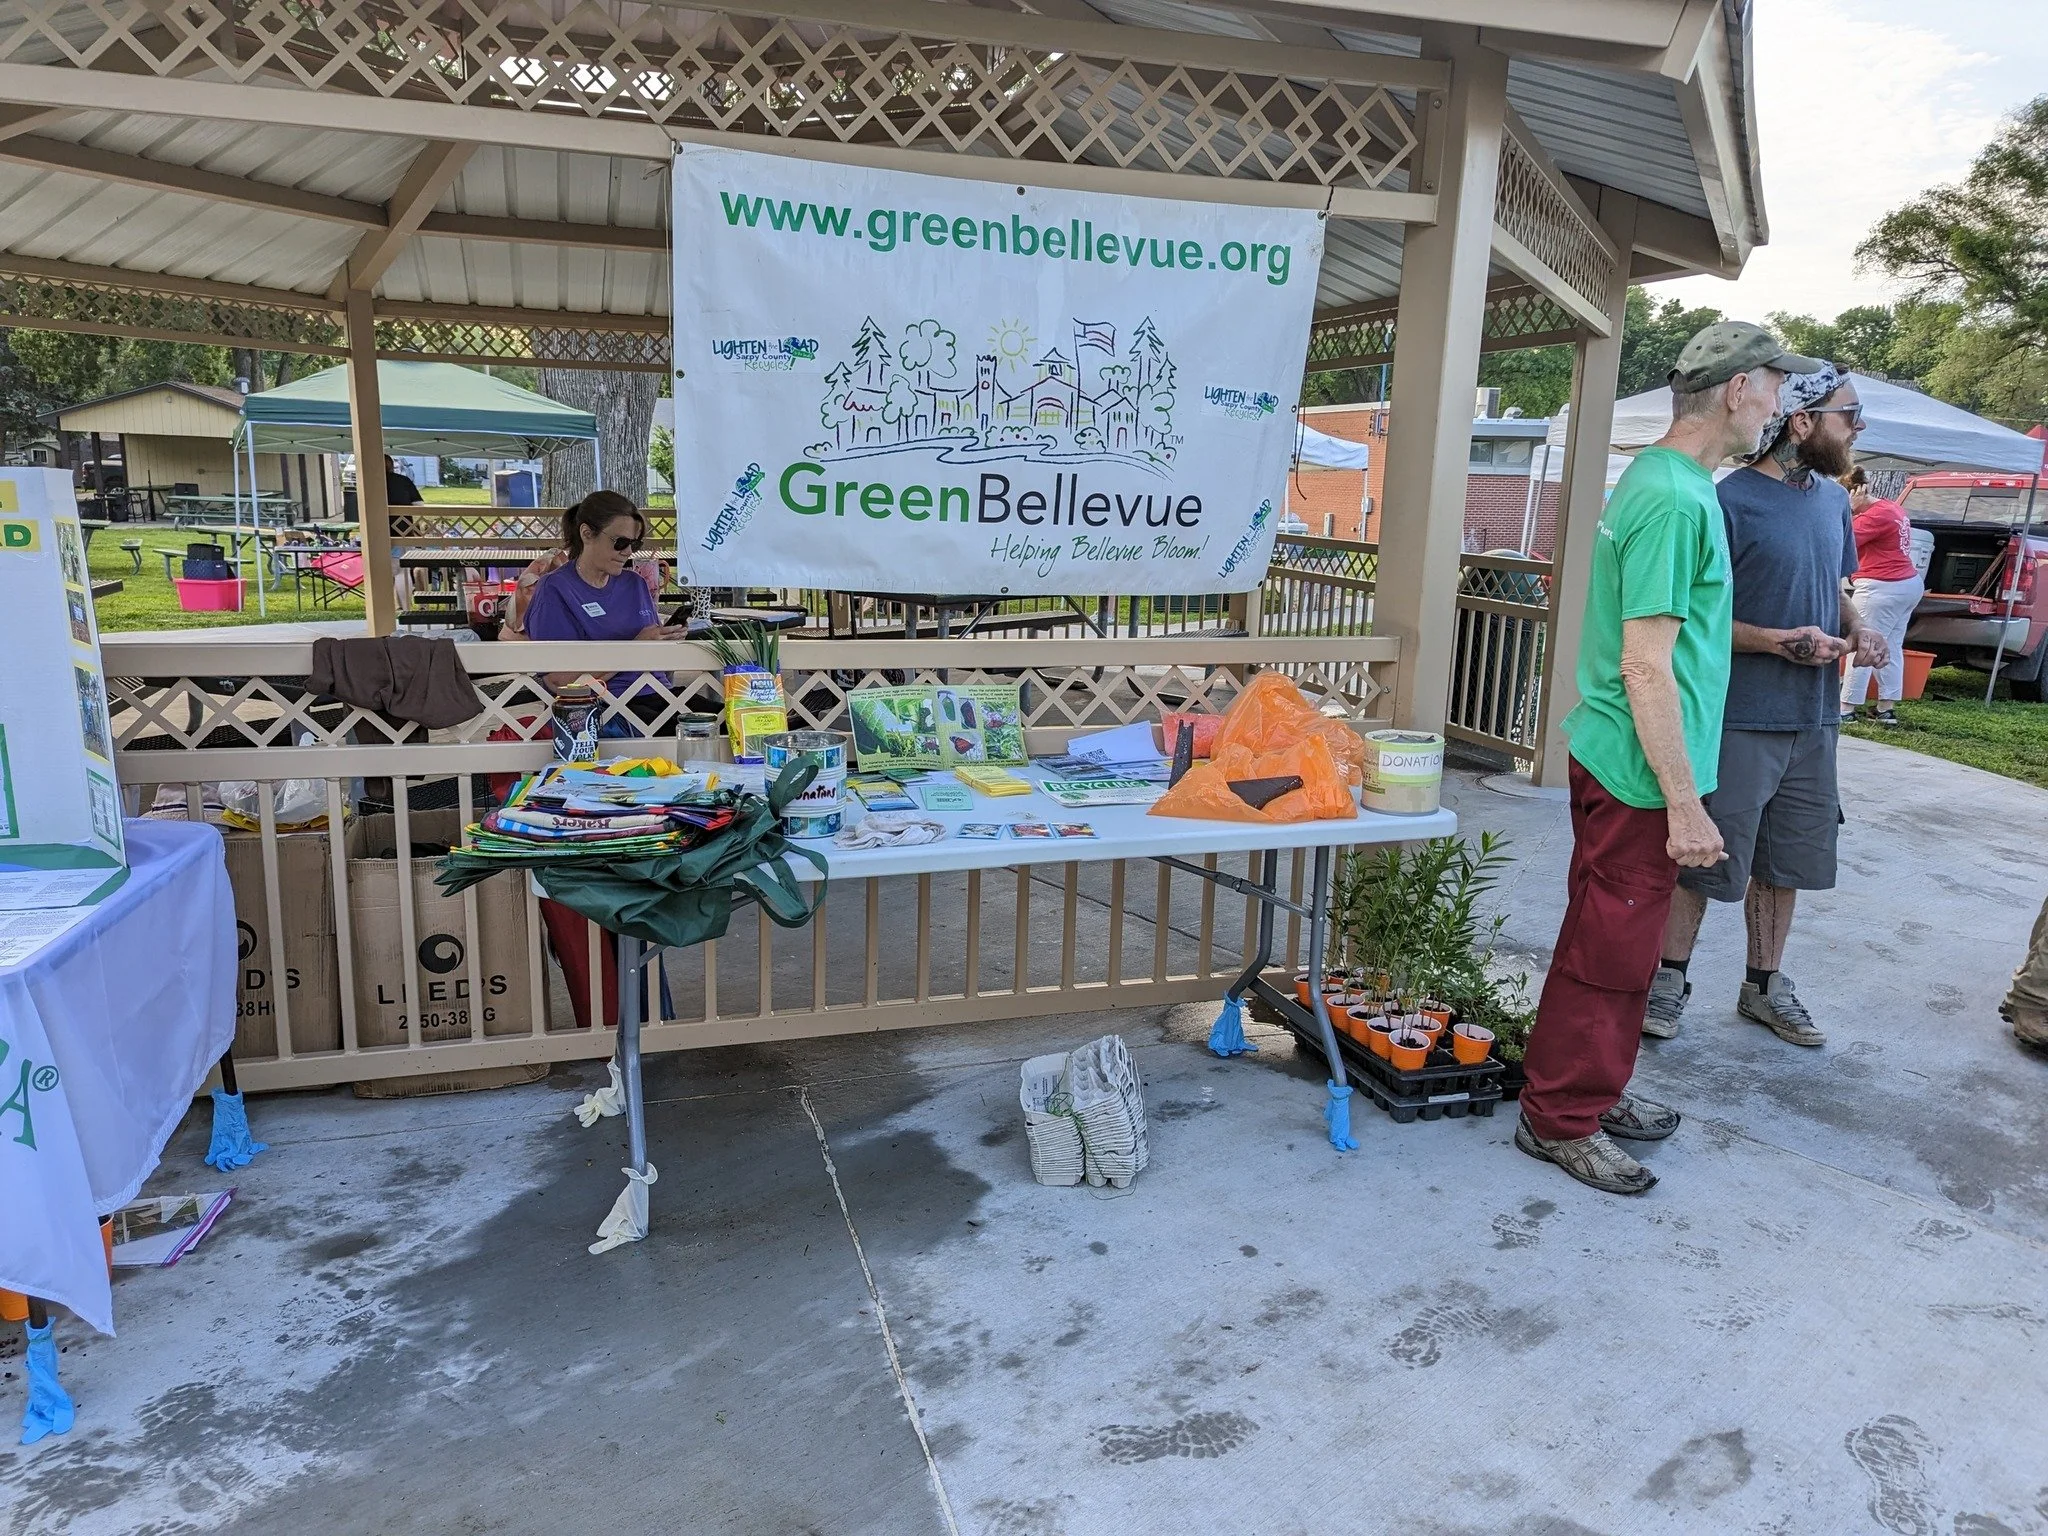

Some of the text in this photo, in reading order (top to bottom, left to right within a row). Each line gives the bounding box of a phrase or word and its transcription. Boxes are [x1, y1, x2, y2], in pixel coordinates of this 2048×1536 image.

[719, 190, 1292, 286] www.greenbellevue.org
[712, 339, 767, 360] LIGHTEN
[736, 353, 759, 361] Sarpy
[762, 353, 792, 361] County
[1204, 386, 1246, 405] LIGHTEN
[701, 503, 737, 551] LIGHTEN
[991, 533, 1211, 578] Helping Bellevue Bloom!
[377, 975, 508, 1005] LED'S
[398, 1007, 496, 1030] 250-38G
